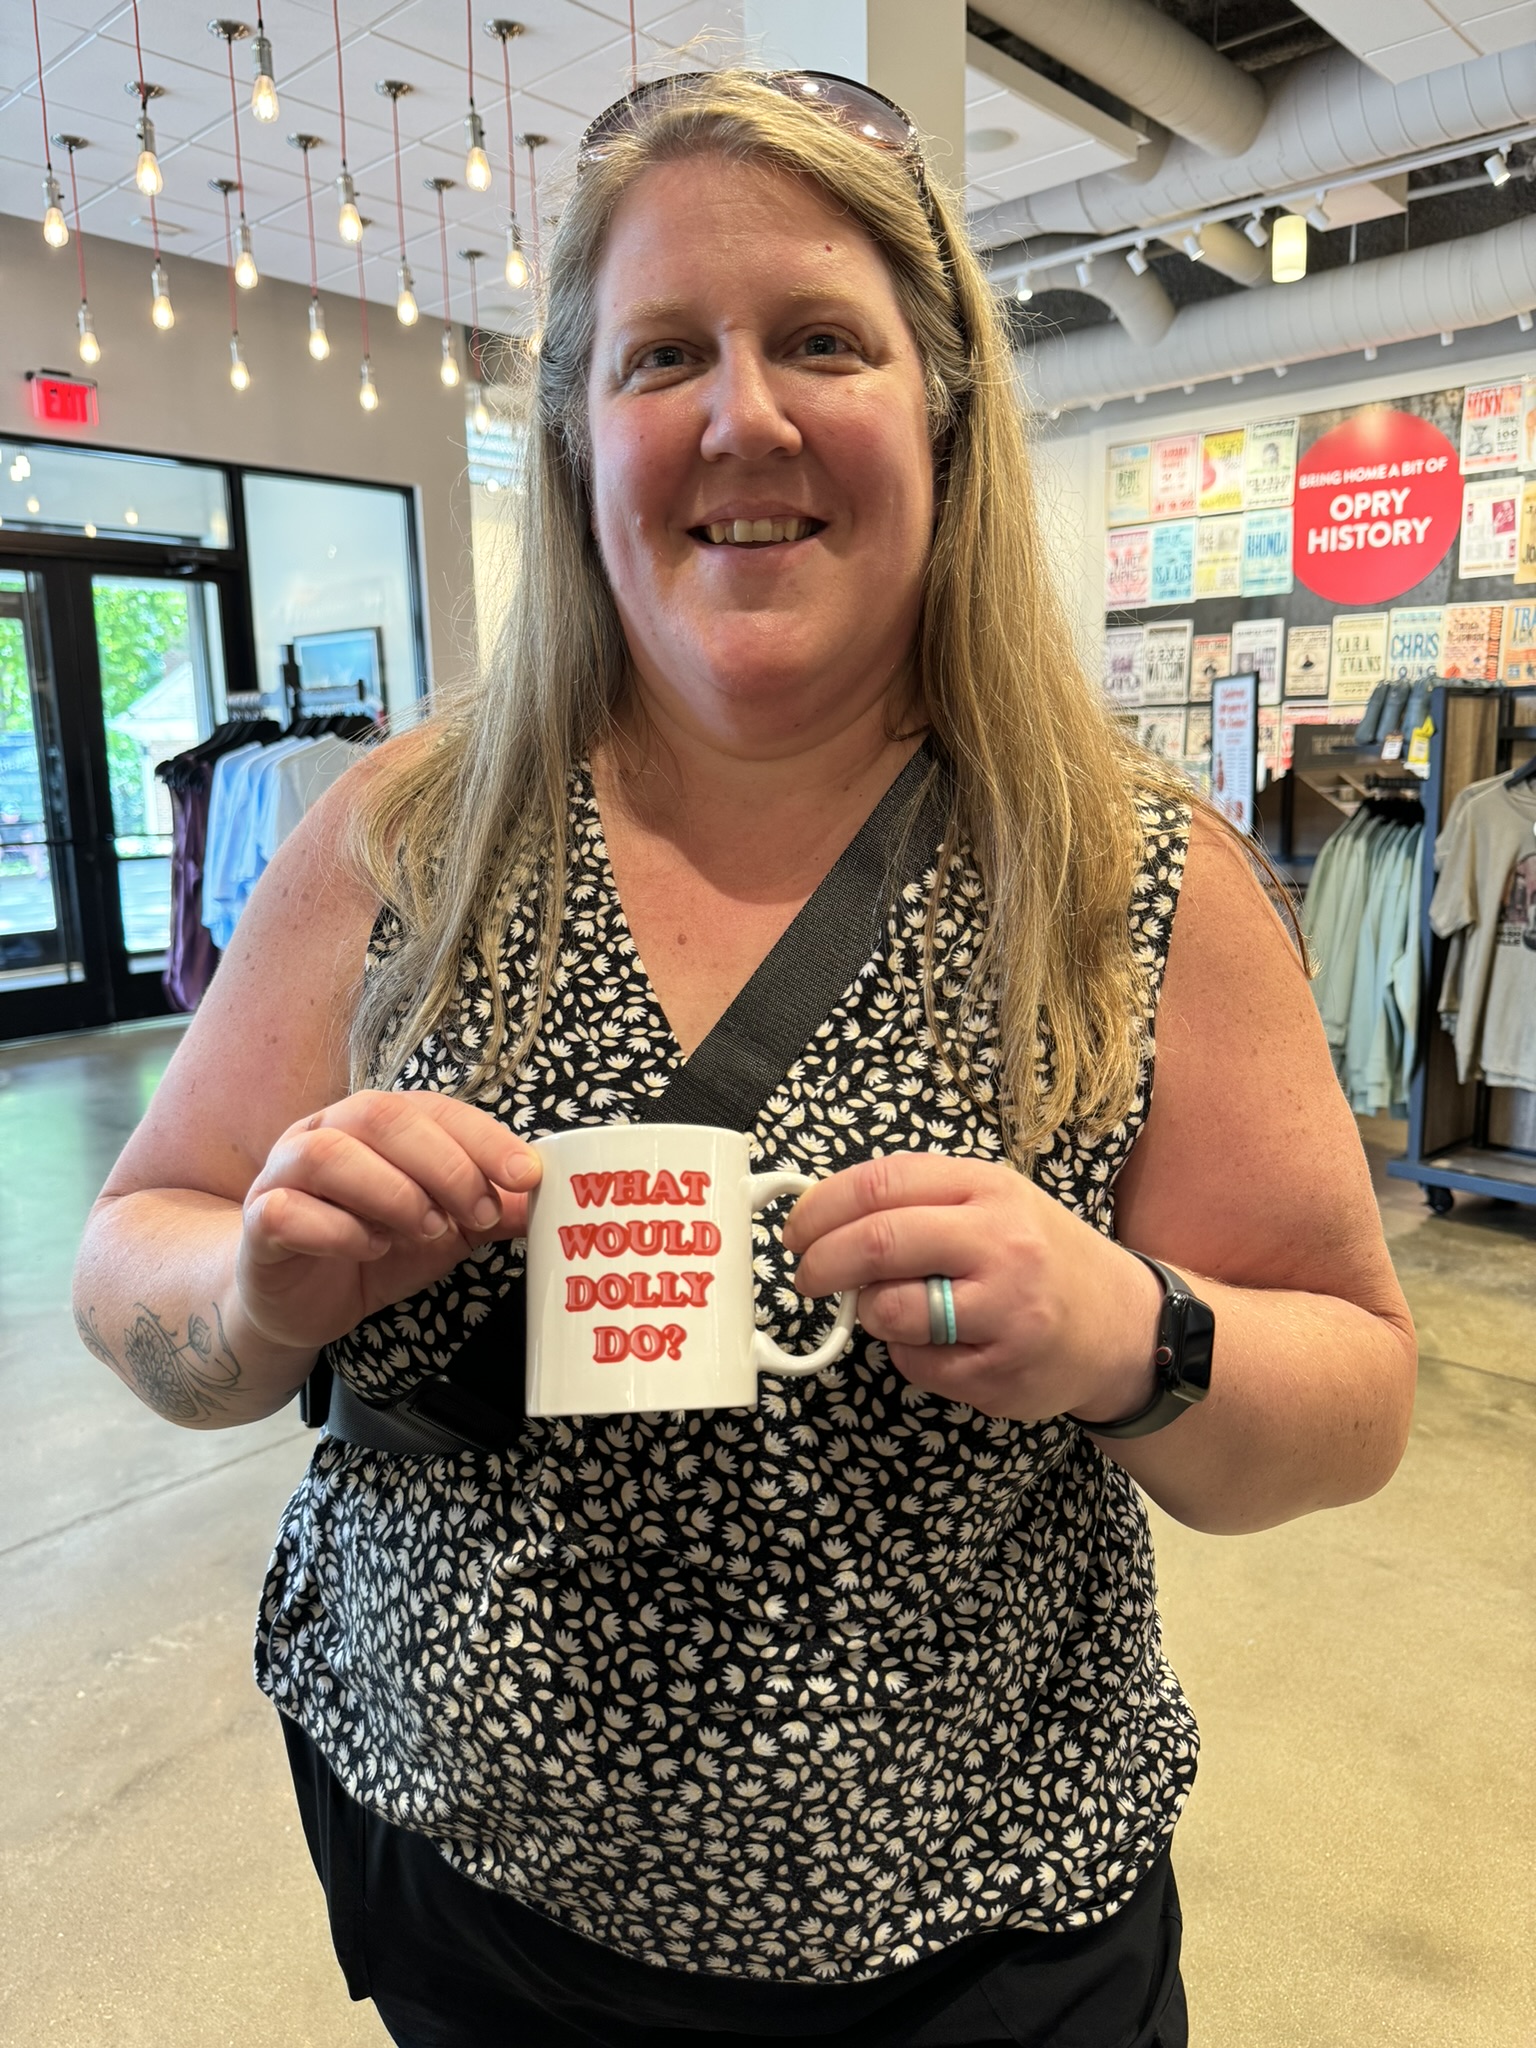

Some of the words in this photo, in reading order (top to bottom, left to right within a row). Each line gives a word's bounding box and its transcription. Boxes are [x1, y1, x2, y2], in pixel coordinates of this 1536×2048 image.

[42, 379, 88, 422] EXIT
[1299, 470, 1341, 489] BRING
[1343, 464, 1387, 483] HOME
[1388, 463, 1399, 478] A
[1401, 459, 1424, 476] BIT
[1425, 456, 1448, 473] OF
[1329, 487, 1411, 521] OPRY
[1308, 516, 1433, 554] HISTORY
[1391, 632, 1440, 660] CHRIS
[569, 1169, 711, 1209] WHAT
[557, 1220, 722, 1261] WOULD
[564, 1271, 715, 1312] DOLLY
[593, 1323, 687, 1364] DO?
